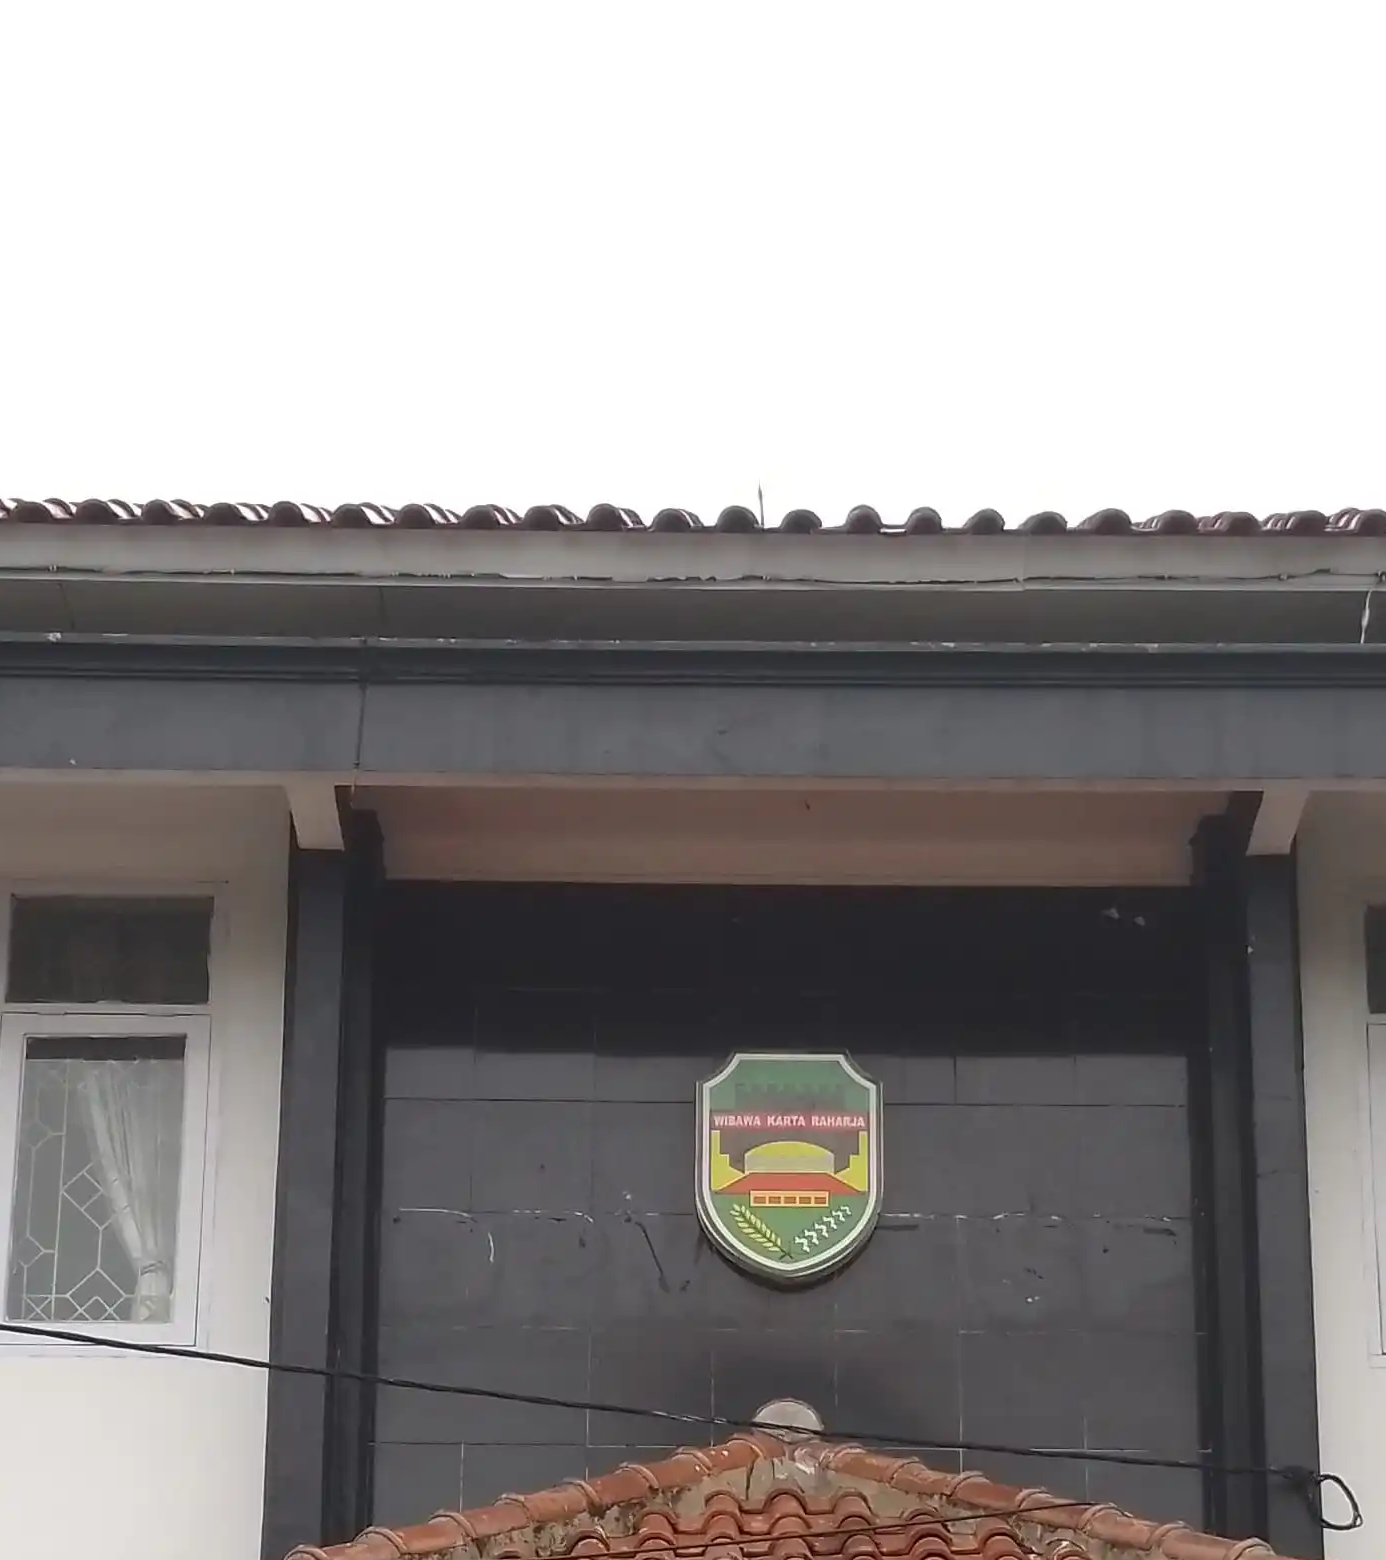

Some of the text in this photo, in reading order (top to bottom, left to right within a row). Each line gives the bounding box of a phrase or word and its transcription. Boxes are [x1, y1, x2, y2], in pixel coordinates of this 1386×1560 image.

[713, 1114, 866, 1128] WIBAWA KARTA RAHARJA
